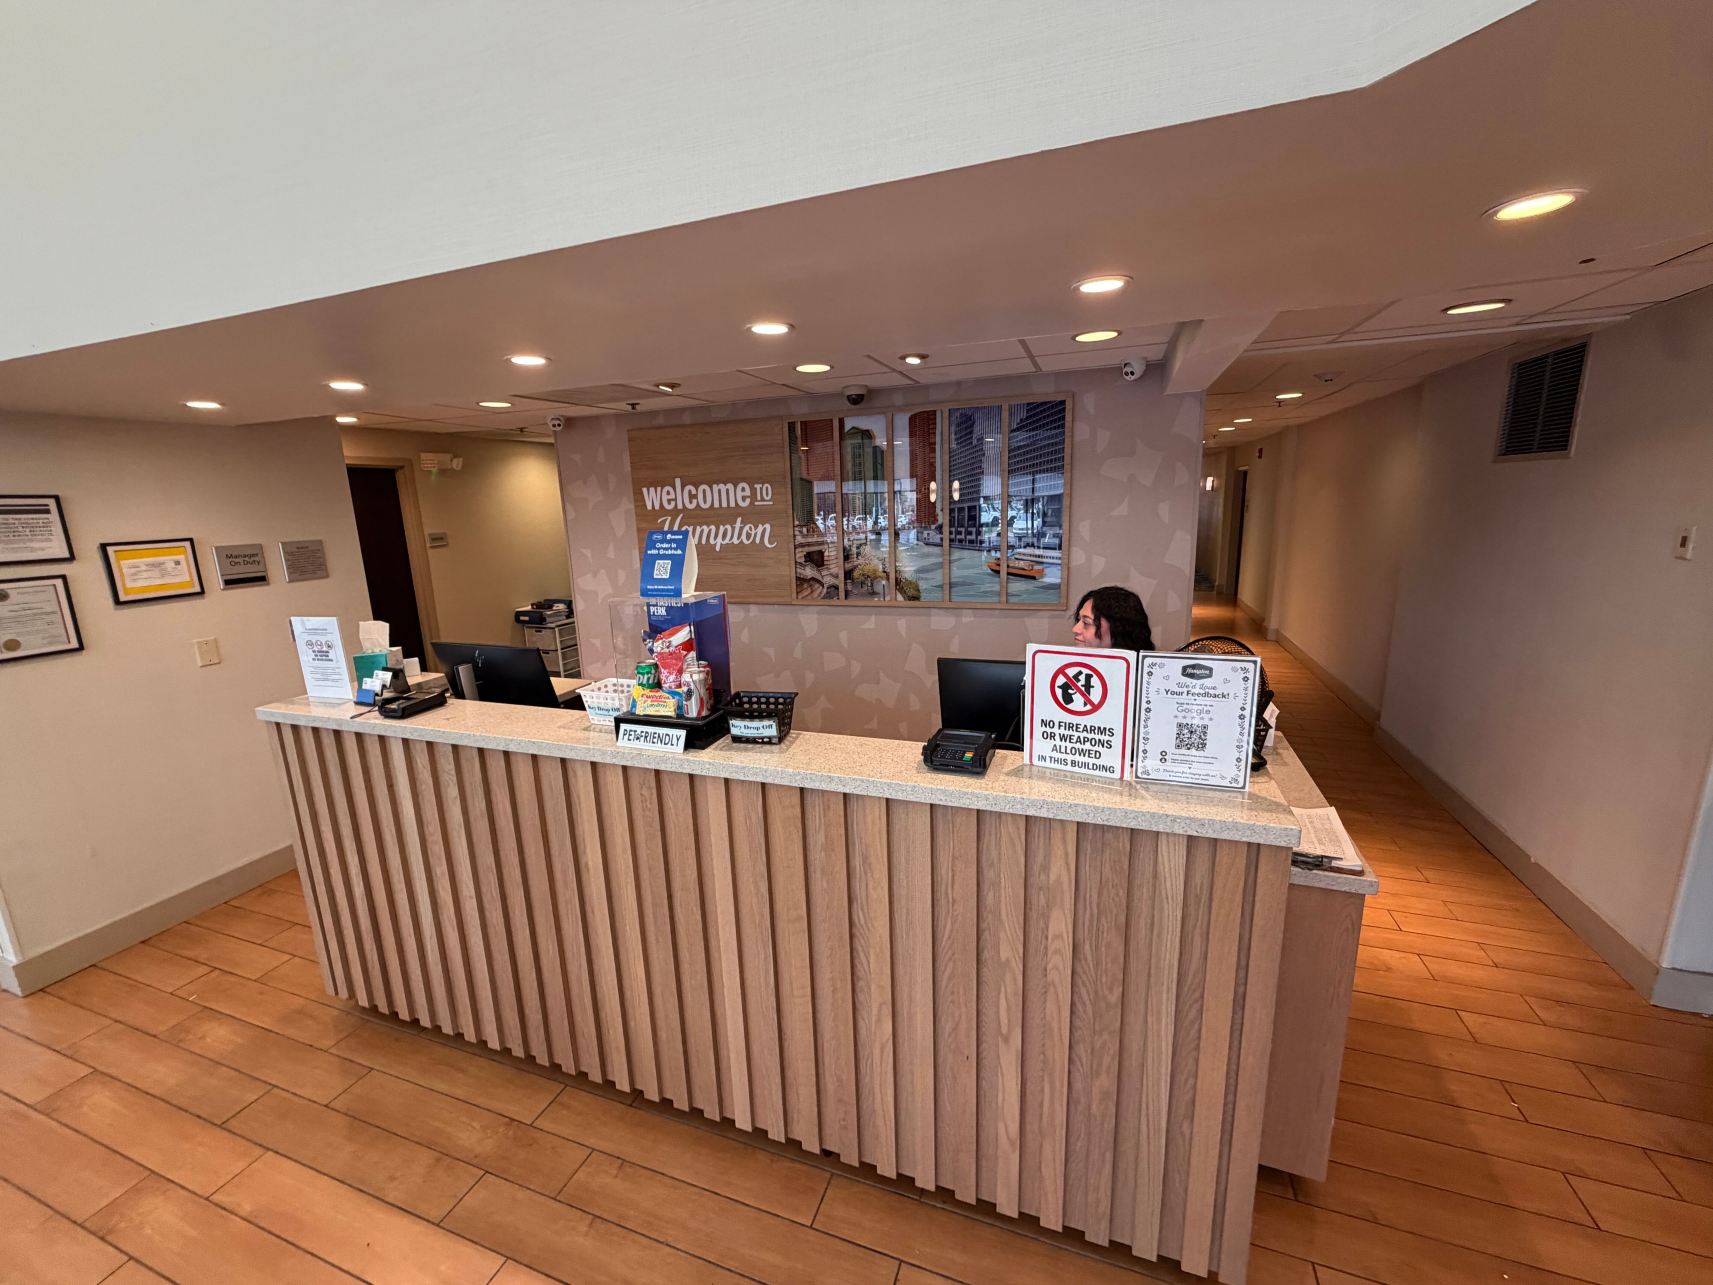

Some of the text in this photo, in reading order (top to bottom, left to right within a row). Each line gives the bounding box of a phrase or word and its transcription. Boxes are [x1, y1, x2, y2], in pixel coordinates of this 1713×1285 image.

[641, 477, 773, 510] welcome TO
[225, 552, 259, 560] Manager
[242, 559, 261, 567] Duty
[650, 606, 667, 615] PERK
[1175, 681, 1198, 690] We'd
[1164, 688, 1230, 700] Your Feedback!
[1176, 705, 1211, 716] Google
[731, 722, 742, 731] Key
[1040, 718, 1115, 738] NO FIREARMS
[621, 728, 682, 748] PET FRIENDLY
[1041, 731, 1113, 749] OR WEAPONS
[1051, 743, 1102, 760] ALLOWED
[1037, 754, 1115, 774] IN THIS BUILDING
